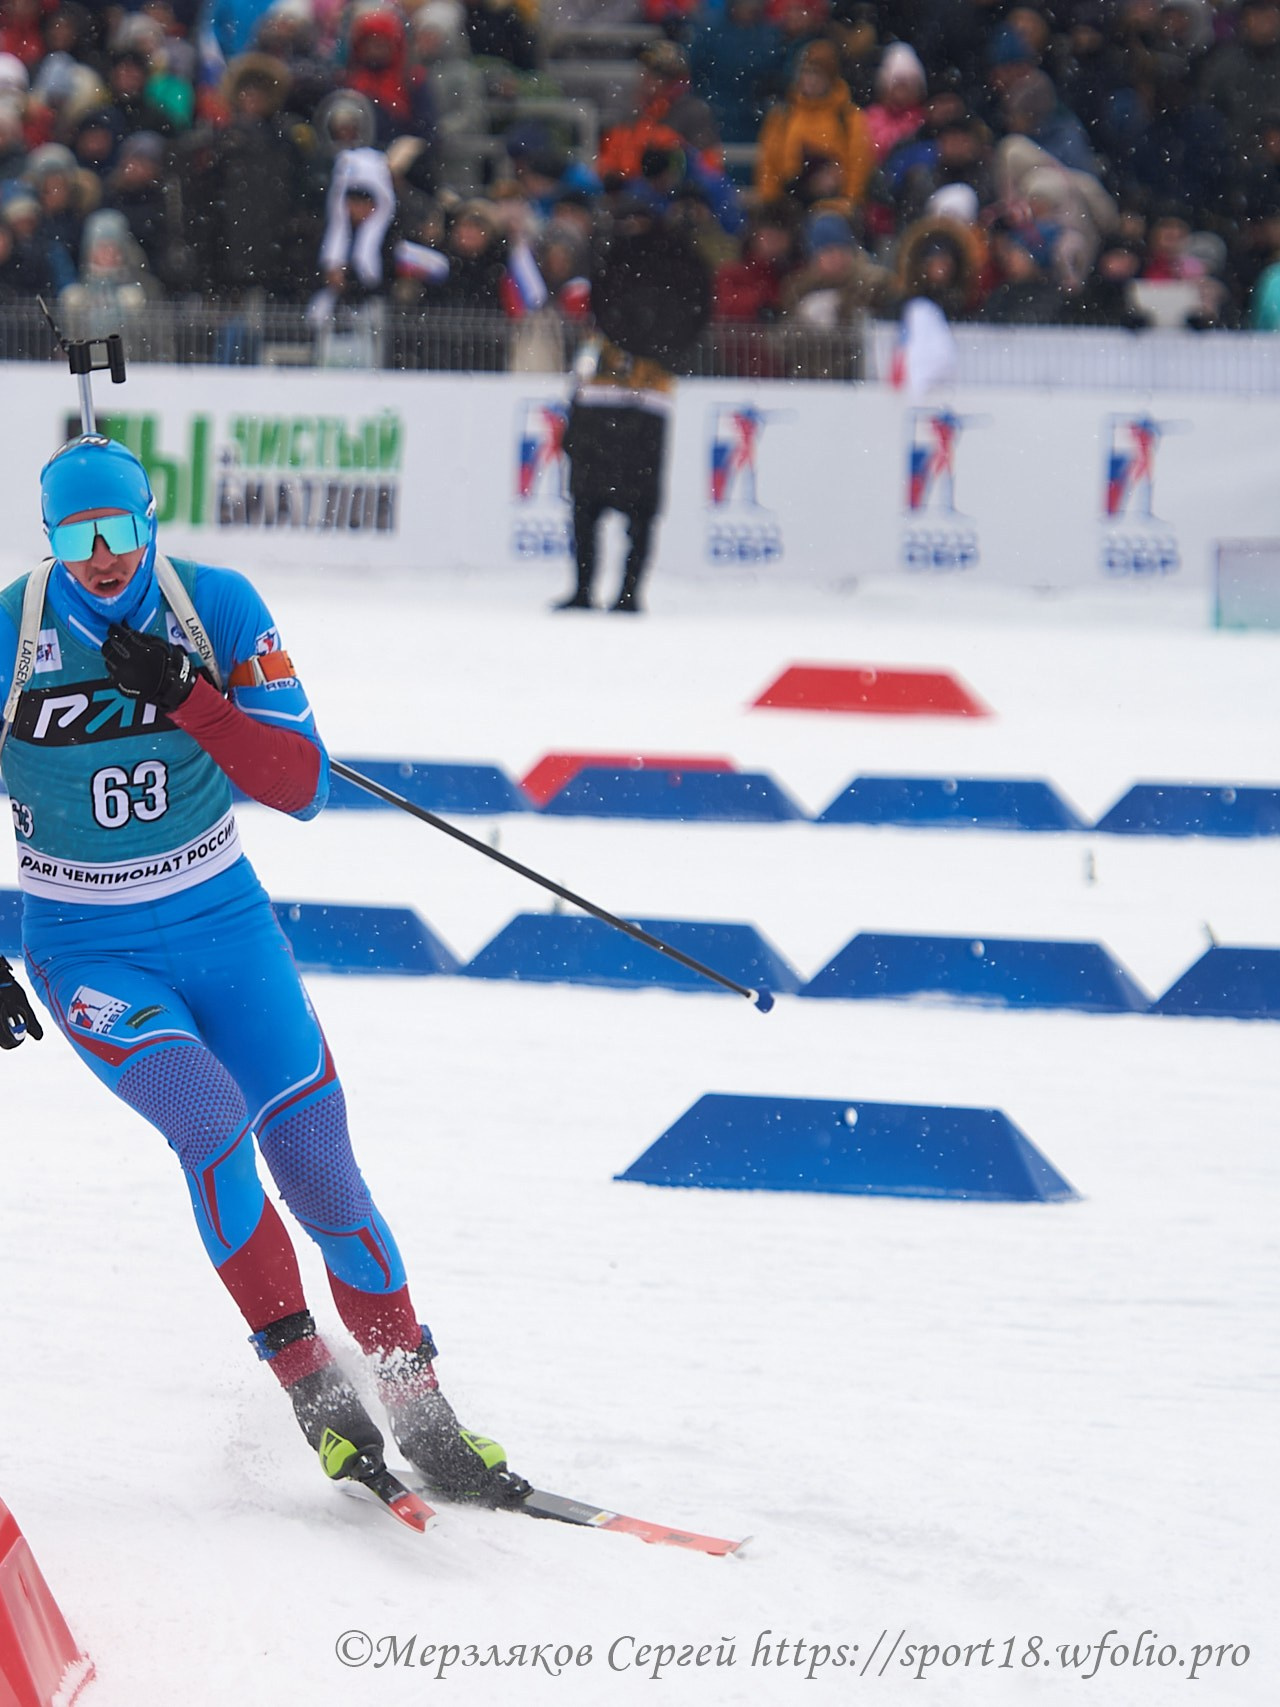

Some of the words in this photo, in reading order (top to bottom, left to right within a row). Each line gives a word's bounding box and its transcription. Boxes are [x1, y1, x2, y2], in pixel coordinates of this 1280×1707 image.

[185, 617, 213, 660] LARSEN
[15, 639, 33, 686] LARSEN
[91, 760, 169, 831] 63
[21, 856, 58, 877] PARI
[63, 855, 183, 885] ЧЕМПИОНАТ
[101, 1003, 129, 1035] RBU
